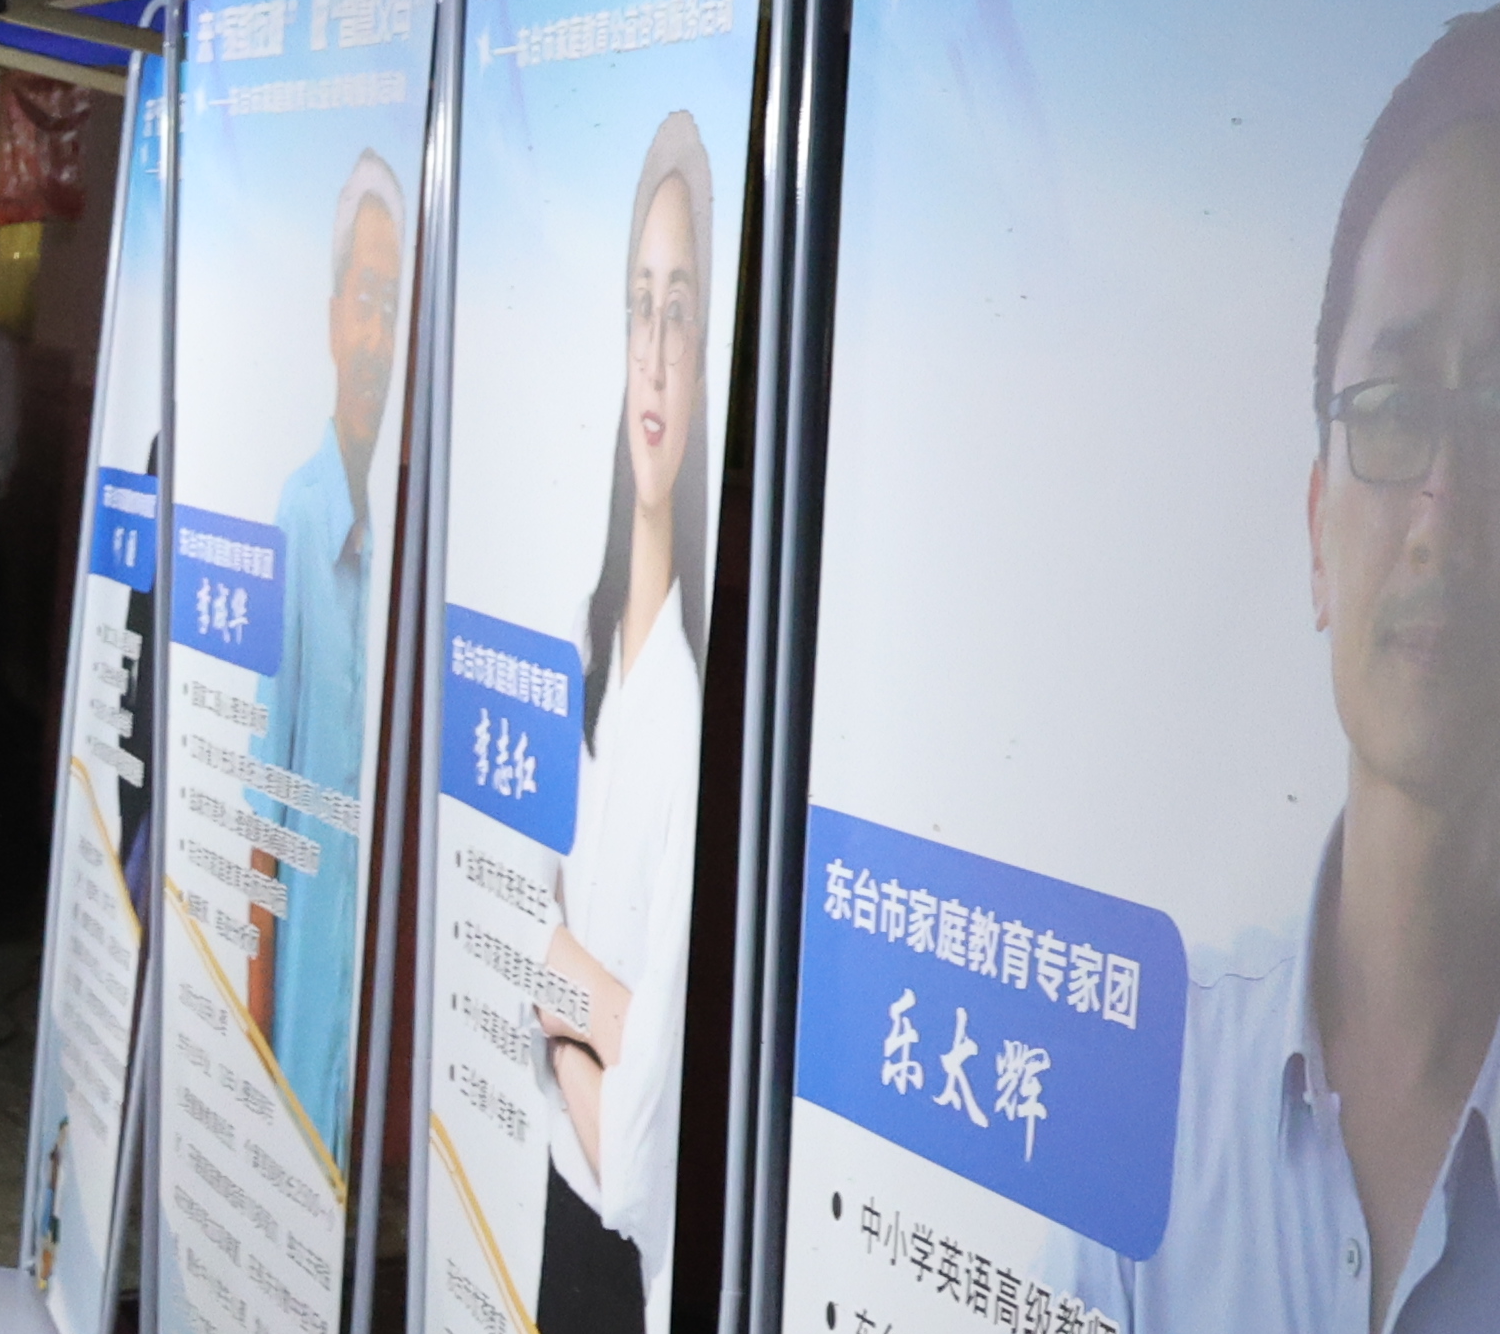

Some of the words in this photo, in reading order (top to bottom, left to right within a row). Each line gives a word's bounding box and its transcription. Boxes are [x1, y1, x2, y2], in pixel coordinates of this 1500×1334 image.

[823, 857, 1142, 1031] 东台市家庭教育专家团
